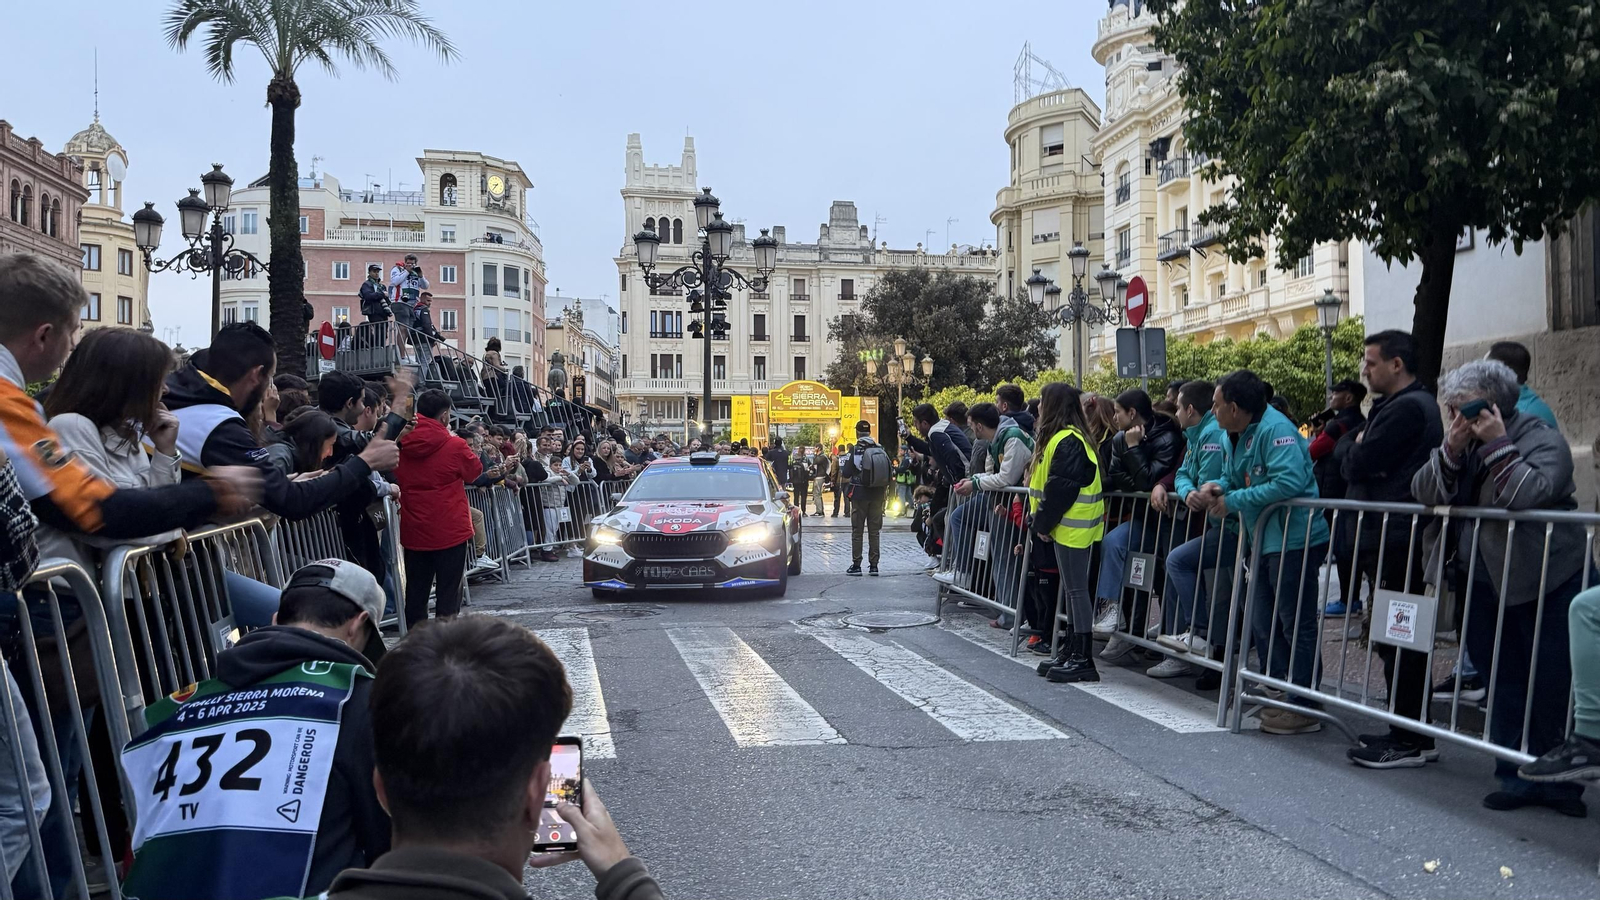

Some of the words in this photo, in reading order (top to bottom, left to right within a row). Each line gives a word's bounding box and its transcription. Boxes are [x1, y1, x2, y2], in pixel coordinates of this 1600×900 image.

[775, 393, 792, 406] 42
[224, 689, 267, 703] SIERRA
[270, 686, 325, 698] MORENA
[177, 710, 186, 723] 4
[197, 707, 206, 719] 6
[207, 704, 231, 718] APR
[234, 700, 267, 713] 2025
[288, 742, 299, 772] MOTORSPORT
[294, 733, 302, 743] CAN
[292, 728, 317, 795] DANGEROUS
[152, 728, 272, 803] 432
[178, 801, 200, 820] TV
